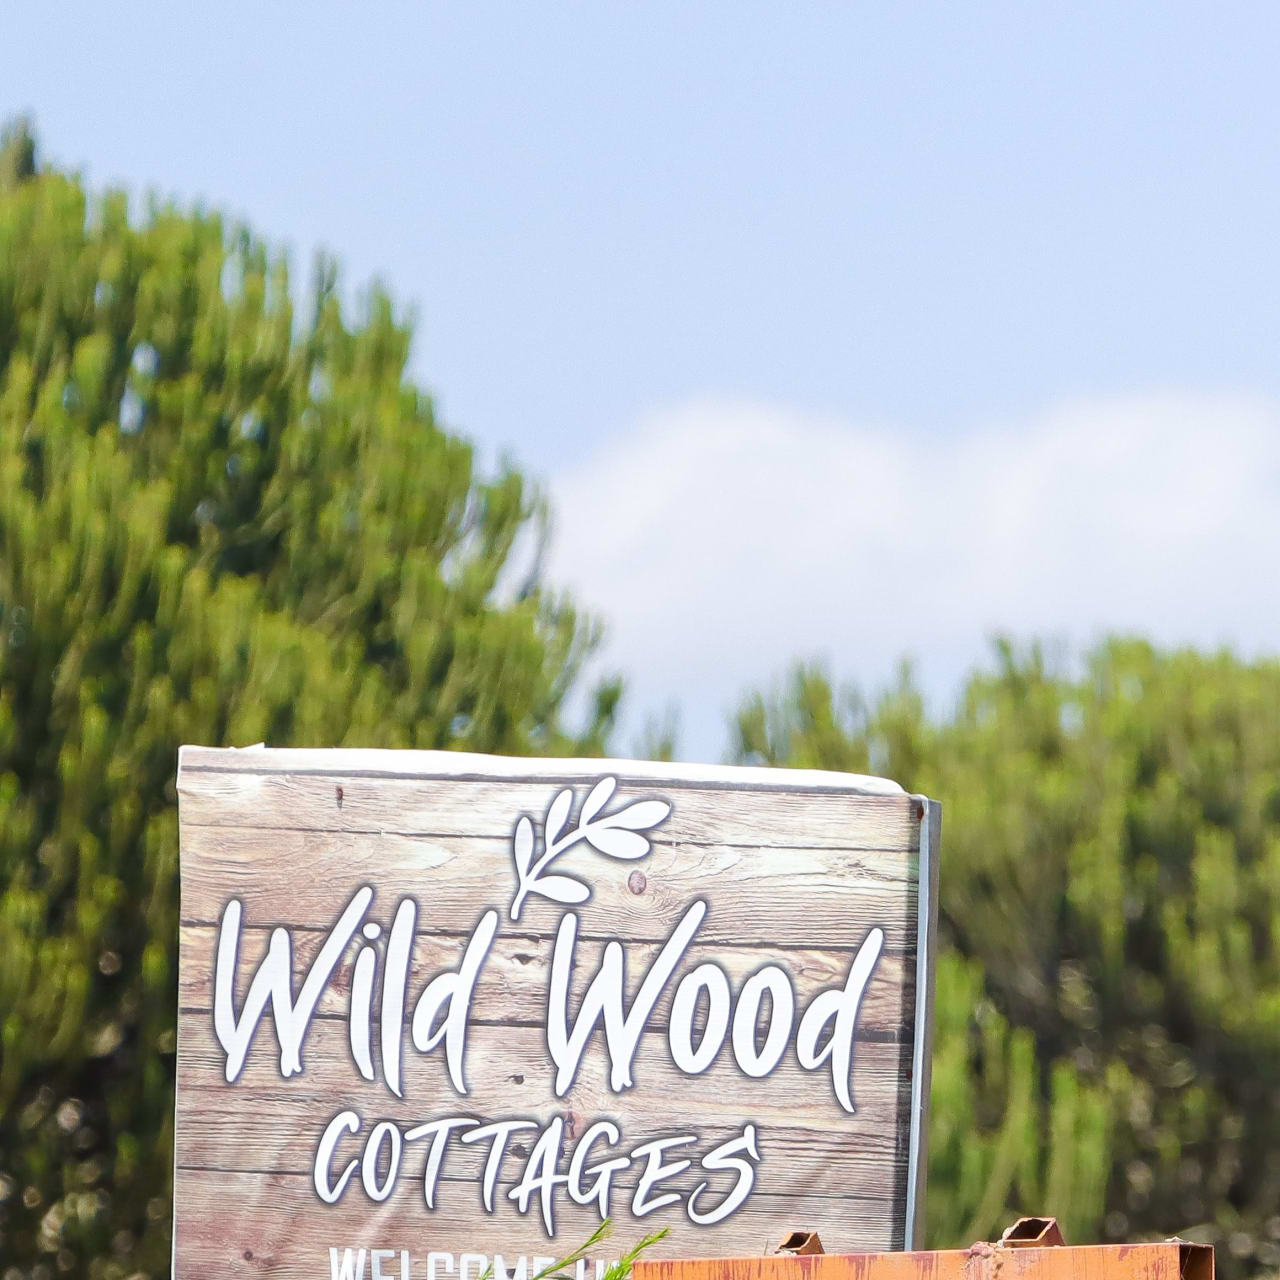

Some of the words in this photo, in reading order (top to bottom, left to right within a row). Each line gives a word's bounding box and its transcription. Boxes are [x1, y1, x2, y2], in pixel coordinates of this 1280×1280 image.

[213, 886, 499, 1098] Wild
[545, 899, 885, 1114] Wood
[313, 1109, 761, 1238] COTTAGES
